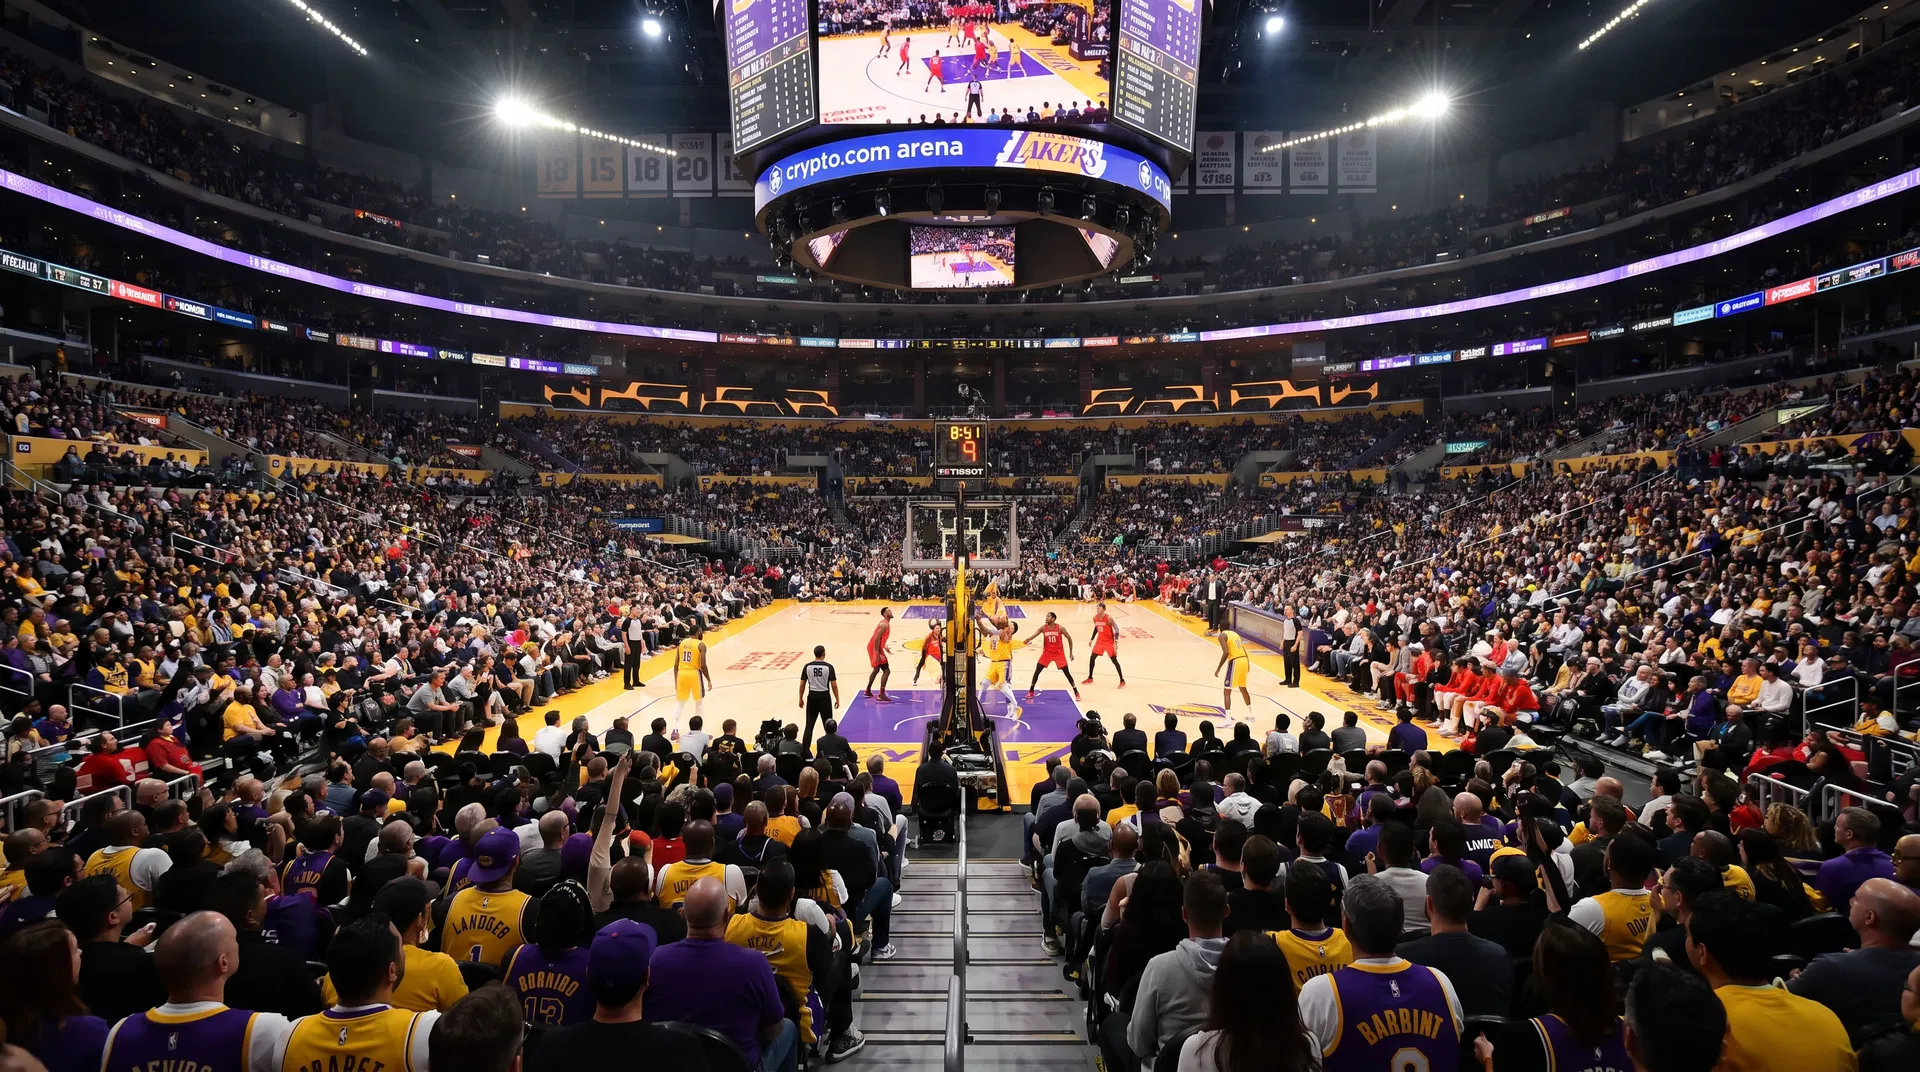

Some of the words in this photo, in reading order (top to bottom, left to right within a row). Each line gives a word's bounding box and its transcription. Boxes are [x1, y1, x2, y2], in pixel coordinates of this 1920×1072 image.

[676, 156, 708, 182] 20
[786, 144, 890, 181] crypto.com
[897, 140, 964, 158] arena
[1006, 130, 1100, 176] LAKERS
[963, 440, 977, 462] 9
[950, 468, 984, 476] TISSOT
[1356, 1008, 1444, 1046] BARBINT
